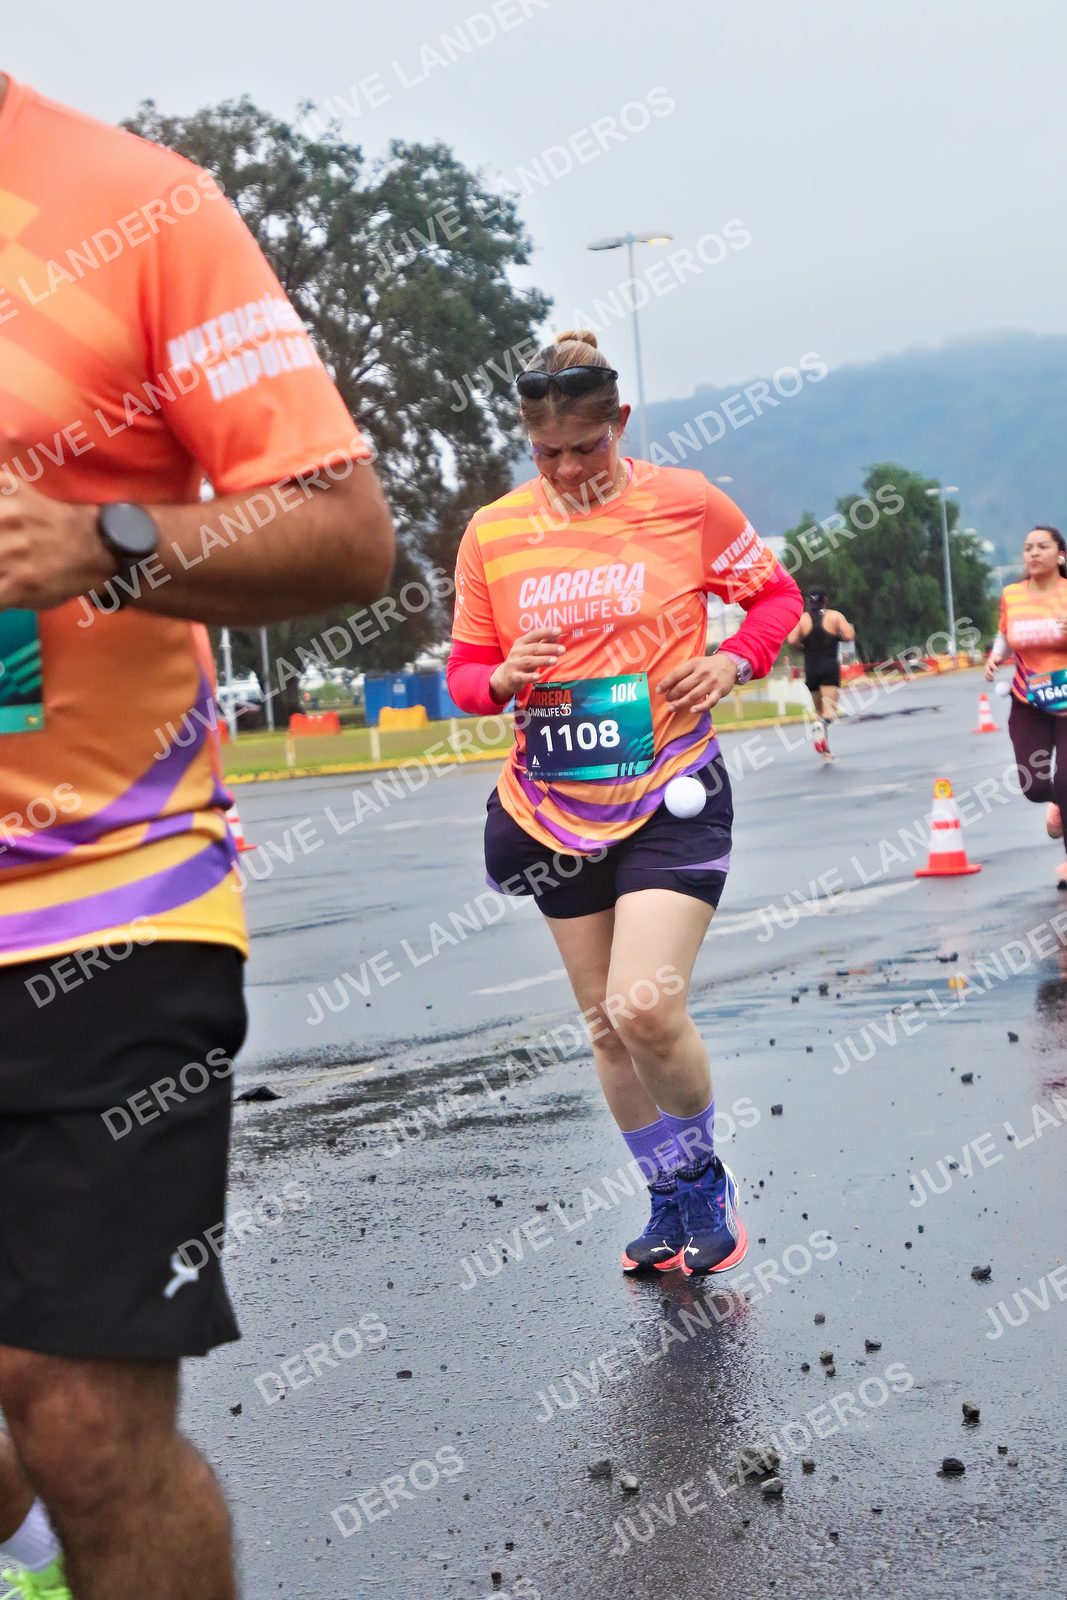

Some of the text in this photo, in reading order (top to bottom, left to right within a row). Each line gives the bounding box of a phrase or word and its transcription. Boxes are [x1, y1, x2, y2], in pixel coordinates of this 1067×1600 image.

[519, 562, 645, 608] CARRERA
[519, 598, 612, 632] OMNILIFE
[572, 628, 584, 638] 10K
[529, 688, 572, 707] ARRERA
[611, 682, 638, 703] 10K
[540, 720, 620, 752] 1108
